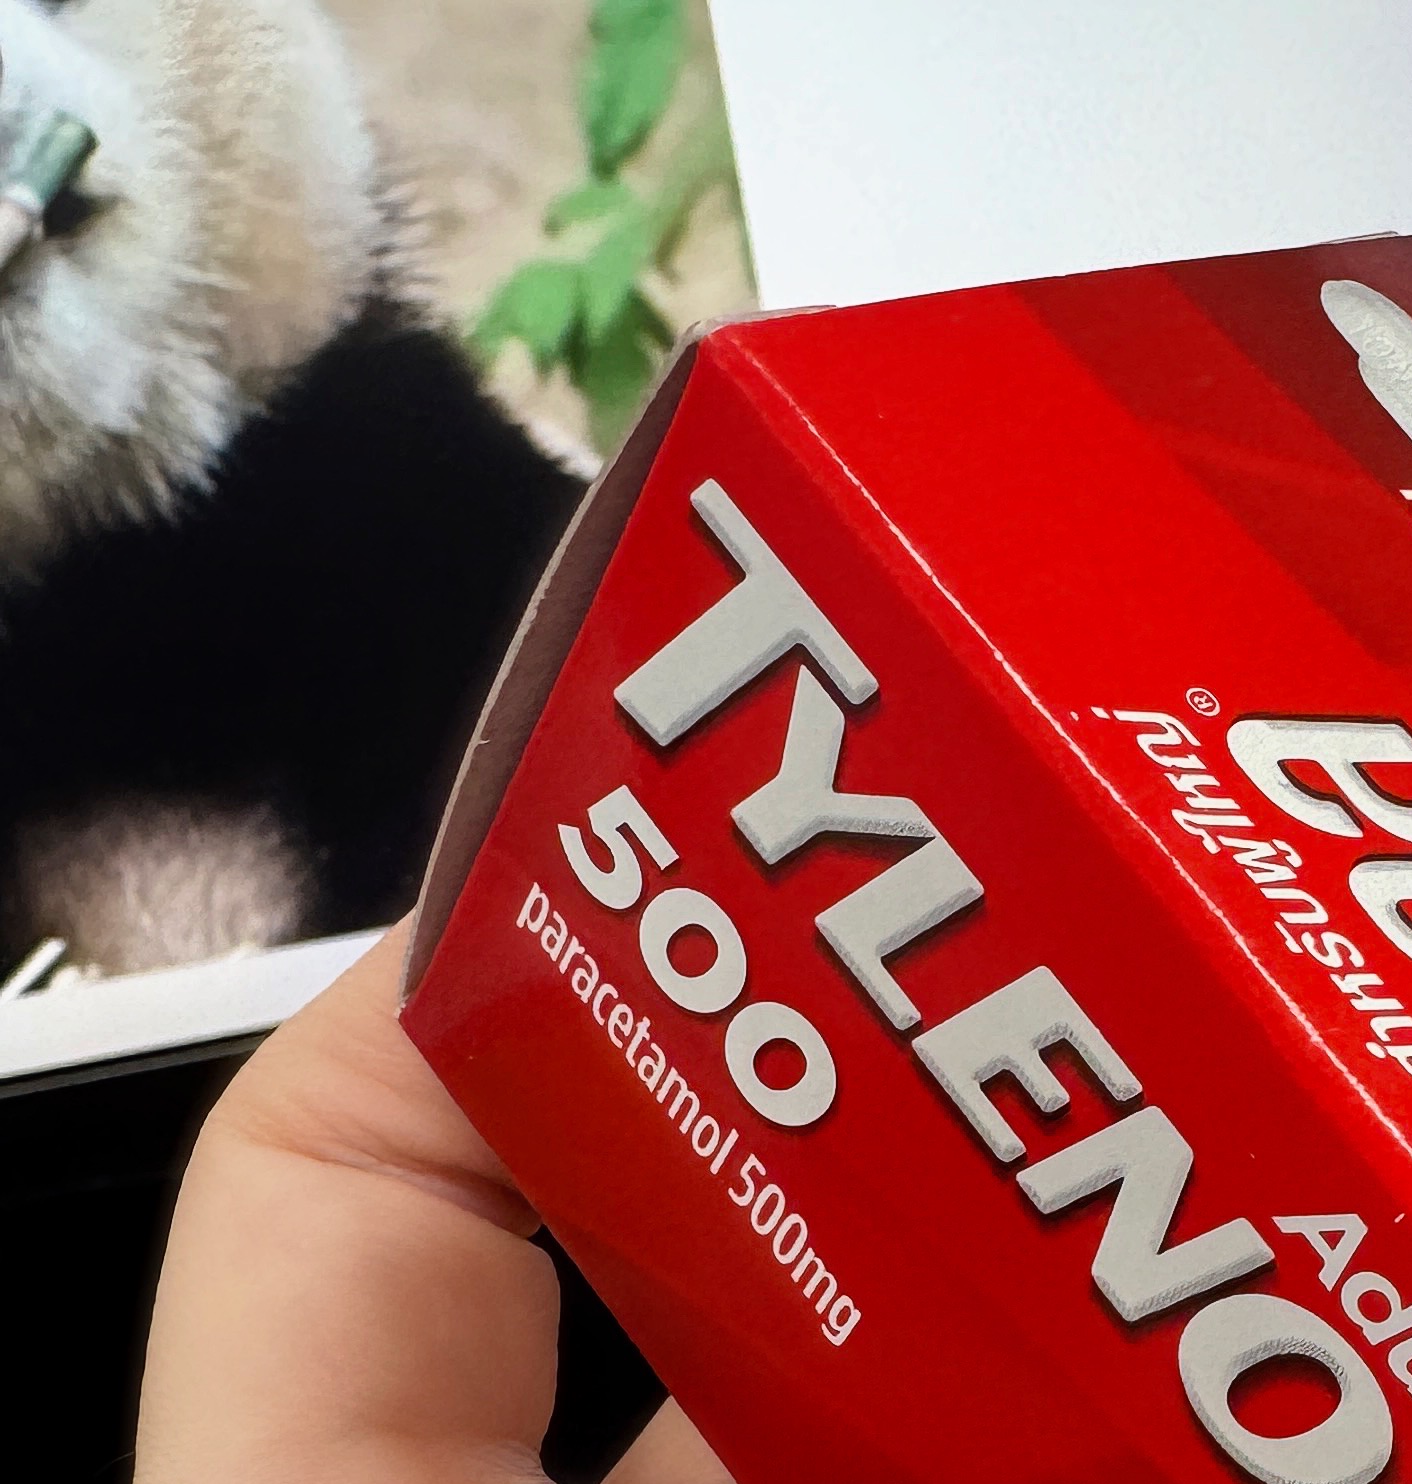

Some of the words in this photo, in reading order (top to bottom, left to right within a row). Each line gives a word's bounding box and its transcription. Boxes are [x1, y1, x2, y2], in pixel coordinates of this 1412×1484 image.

[516, 882, 740, 1176] paracetamol
[732, 1158, 861, 1346] 500mg
[558, 785, 836, 1126] 500
